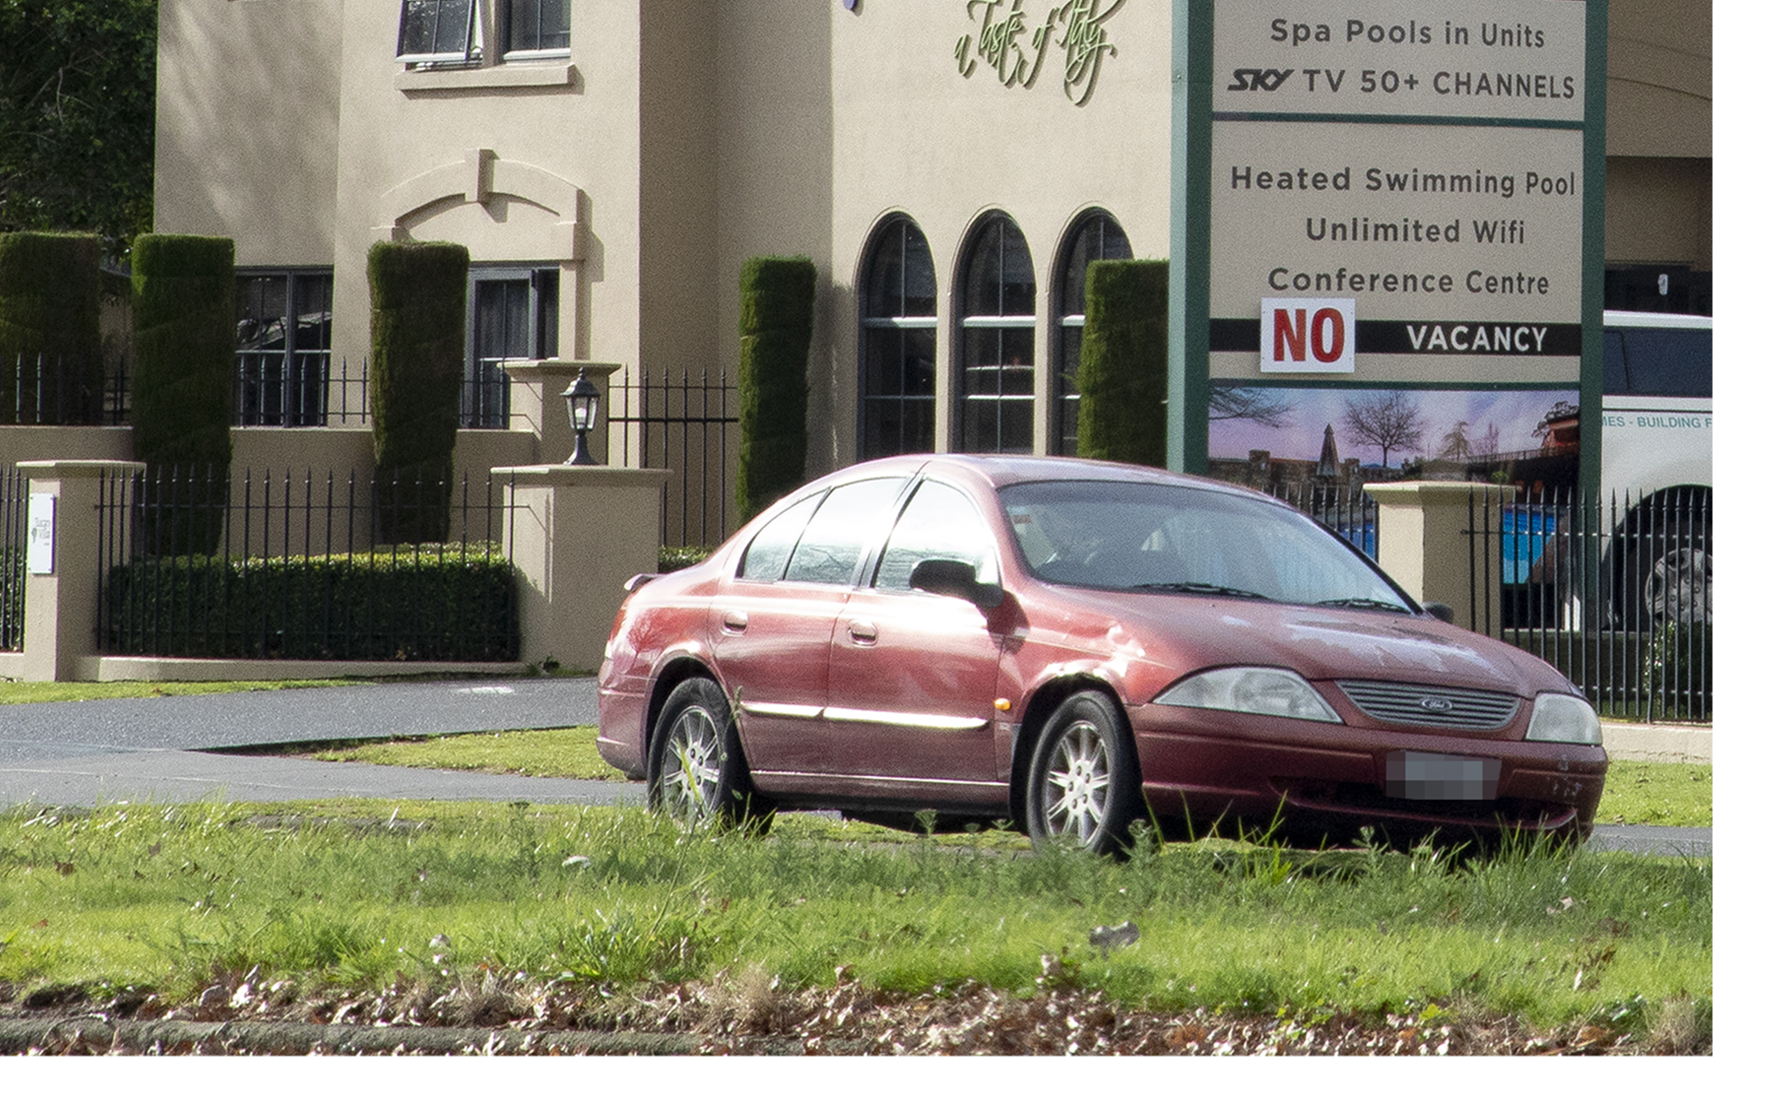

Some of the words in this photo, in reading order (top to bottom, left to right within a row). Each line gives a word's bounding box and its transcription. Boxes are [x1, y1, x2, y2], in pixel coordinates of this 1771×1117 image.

[1270, 18, 1331, 47] Spa
[1346, 19, 1432, 45] Pools
[1445, 21, 1469, 45] in
[1481, 23, 1545, 48] Units
[954, 33, 977, 79] a
[1228, 68, 1295, 92] SKY
[1302, 69, 1346, 93] TV
[1359, 70, 1419, 94] 50+
[1433, 71, 1575, 99] CHANNELS
[1231, 166, 1351, 191] Heated
[1365, 168, 1515, 198] Swimming
[1526, 172, 1576, 196] Pool
[1305, 217, 1461, 243] Unlimited
[1473, 220, 1525, 244] Wifi
[1267, 267, 1454, 295] Conference
[1466, 269, 1550, 295] Centre
[1272, 307, 1346, 363] NO
[1406, 325, 1548, 353] VACANCY
[1636, 416, 1702, 429] BUILDING
